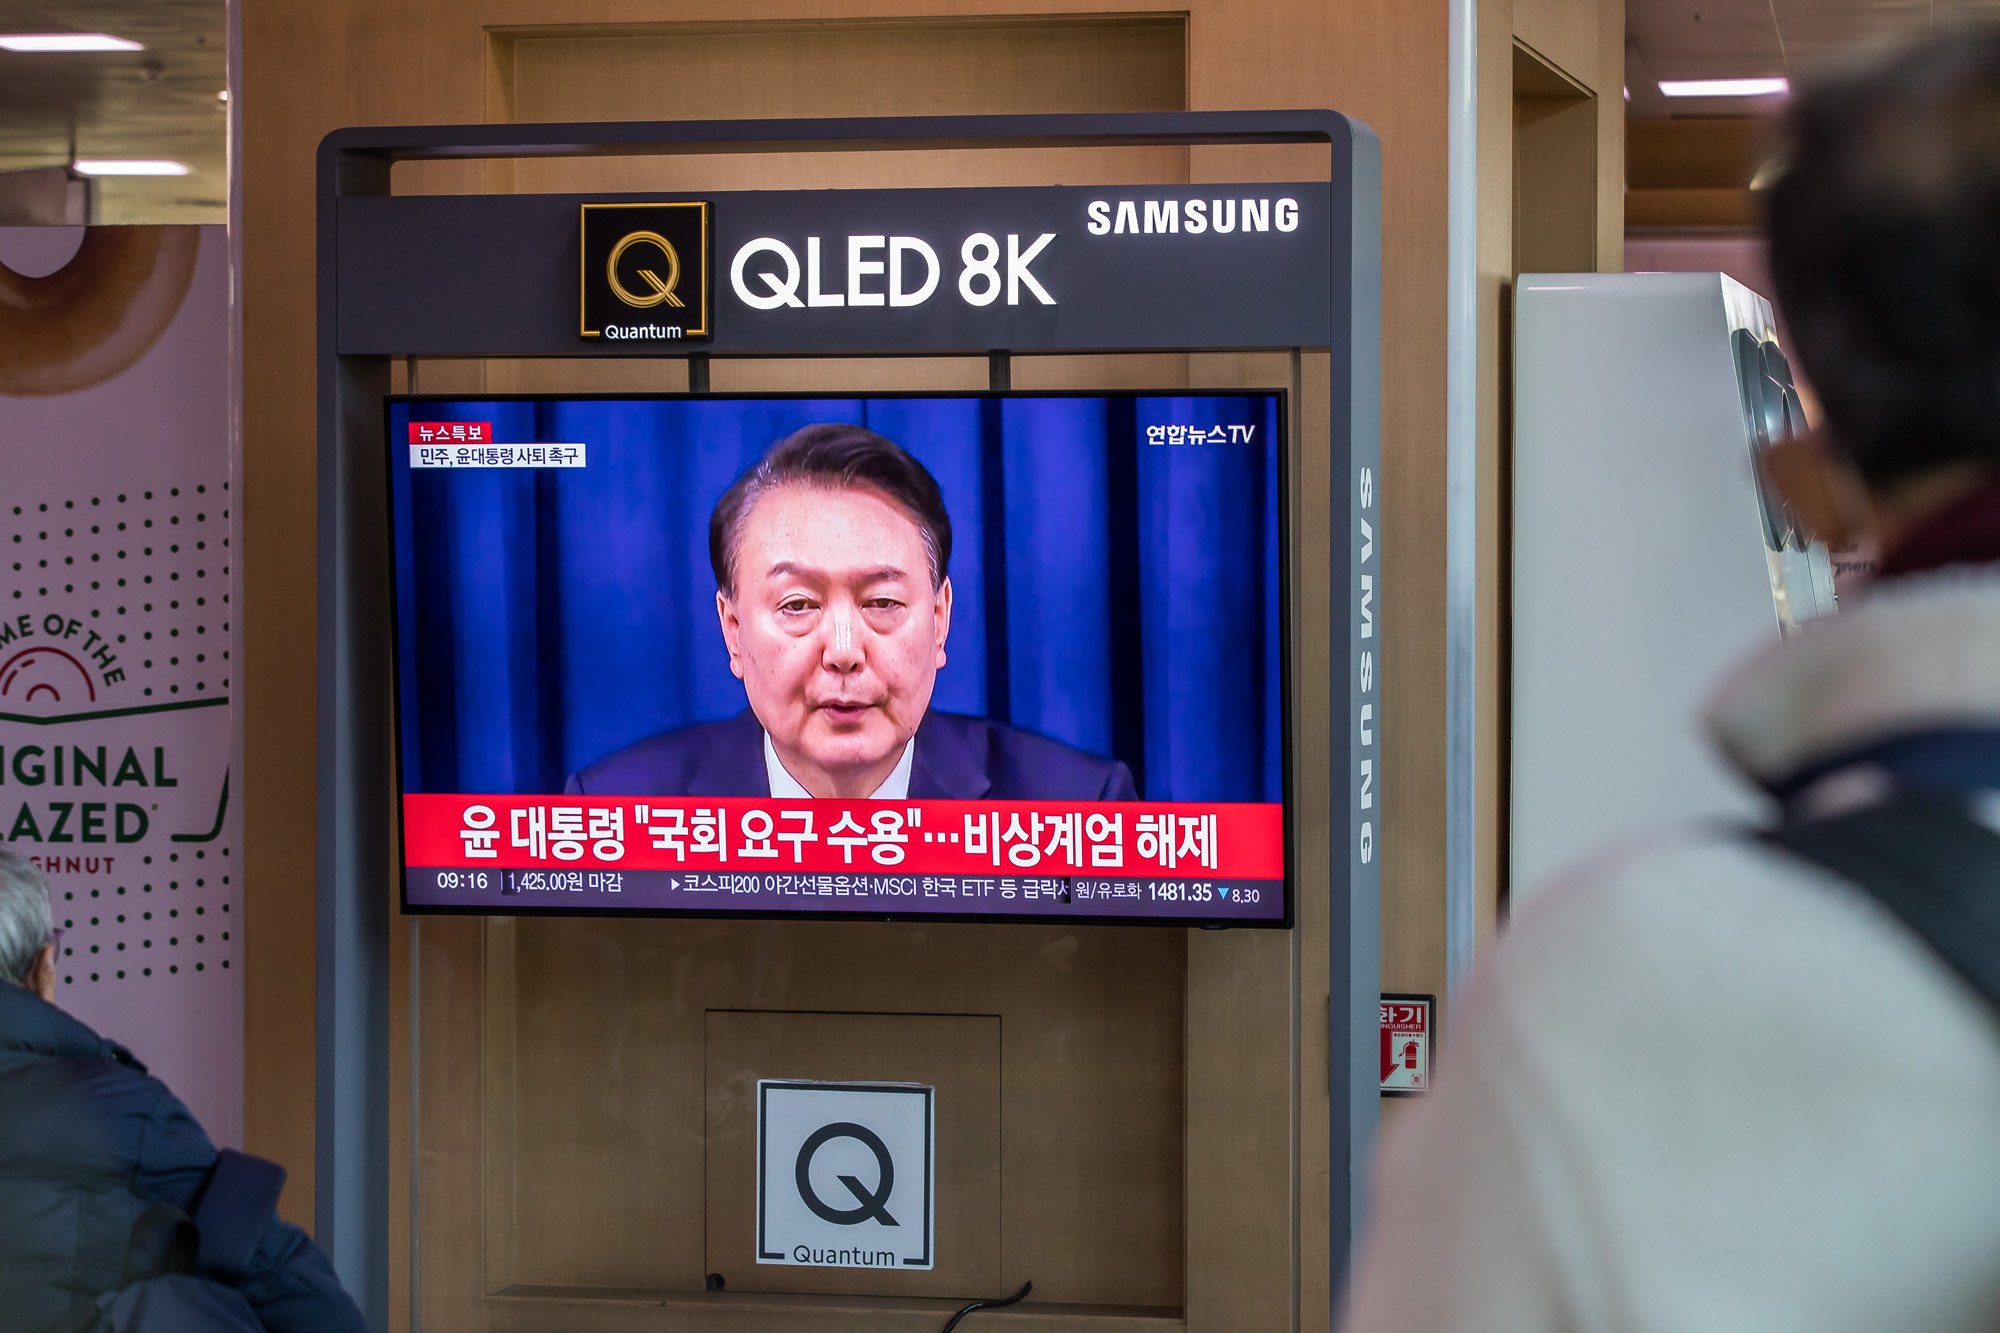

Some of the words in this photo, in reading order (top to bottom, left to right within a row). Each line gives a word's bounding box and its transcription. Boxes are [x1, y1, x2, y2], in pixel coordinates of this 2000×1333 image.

[1086, 197, 1300, 237] SAMSUNG
[606, 230, 686, 309] Q
[729, 234, 942, 310] QLED
[956, 232, 1059, 307] 8K
[605, 323, 681, 339] Quantum
[419, 425, 483, 442] 뉴스특보
[1146, 424, 1255, 445] 연합뉴스TV
[420, 447, 453, 466] 민주,
[455, 447, 514, 465] 윤대통령
[517, 447, 546, 465] 사퇴
[548, 447, 579, 465] 촉구
[43, 613, 83, 639] OF
[82, 629, 126, 687] THE
[1359, 466, 1373, 865] SAMSUNG
[0, 801, 149, 843] AZED
[459, 805, 501, 858] 윤
[510, 805, 625, 861] 대통령
[634, 804, 727, 862] "국회
[737, 809, 818, 863] 요구
[1135, 812, 1218, 870] 해제
[437, 872, 488, 889] 09:16
[508, 872, 584, 893] 1,425.00원
[588, 872, 624, 893] 마감
[683, 874, 760, 895] 코스피200
[922, 877, 957, 898] 한국
[962, 879, 995, 897] ETF
[999, 879, 1018, 899] 등
[1148, 882, 1212, 902] 1481.35
[1231, 889, 1260, 904] 8.30
[795, 1122, 901, 1226] Q
[793, 1244, 895, 1266] Quantum
